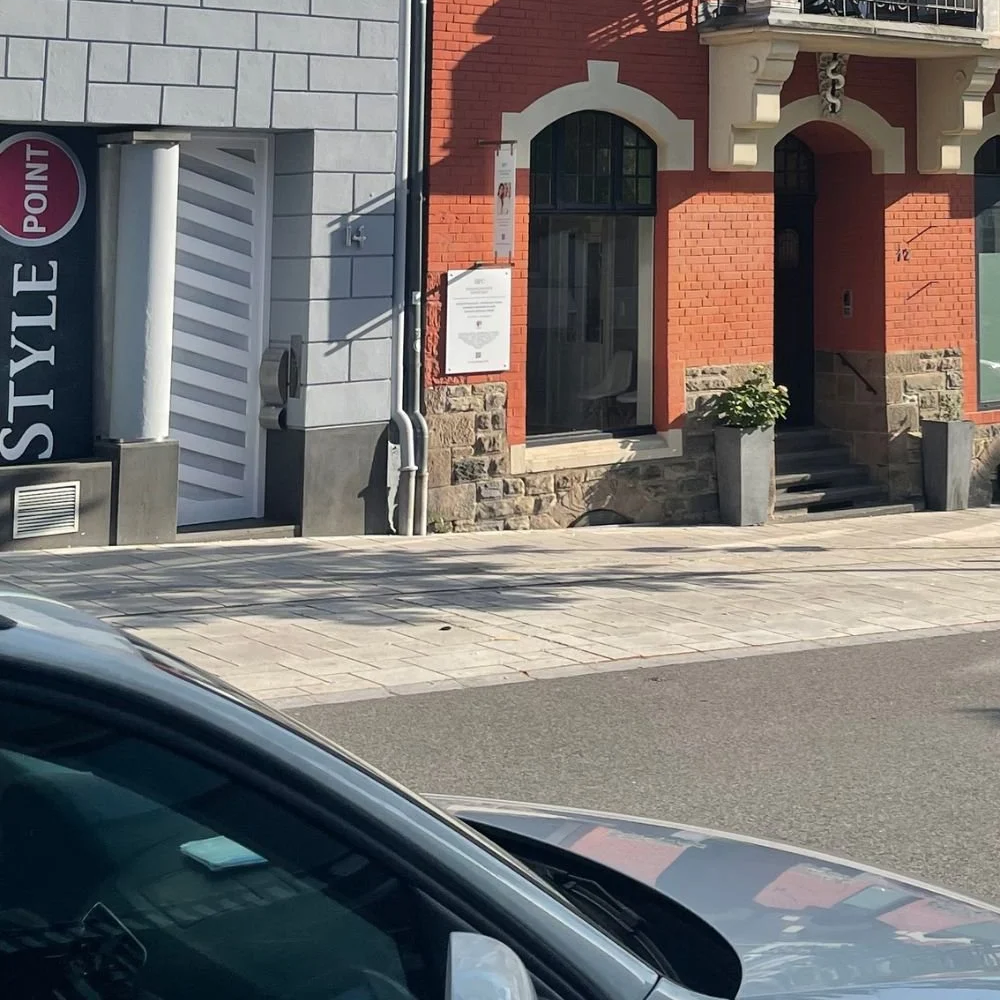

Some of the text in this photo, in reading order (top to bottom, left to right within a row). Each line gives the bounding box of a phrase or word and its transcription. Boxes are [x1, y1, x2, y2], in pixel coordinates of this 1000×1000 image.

[22, 143, 49, 234] POINT
[896, 248, 910, 262] 12
[0, 260, 59, 461] STYLE
